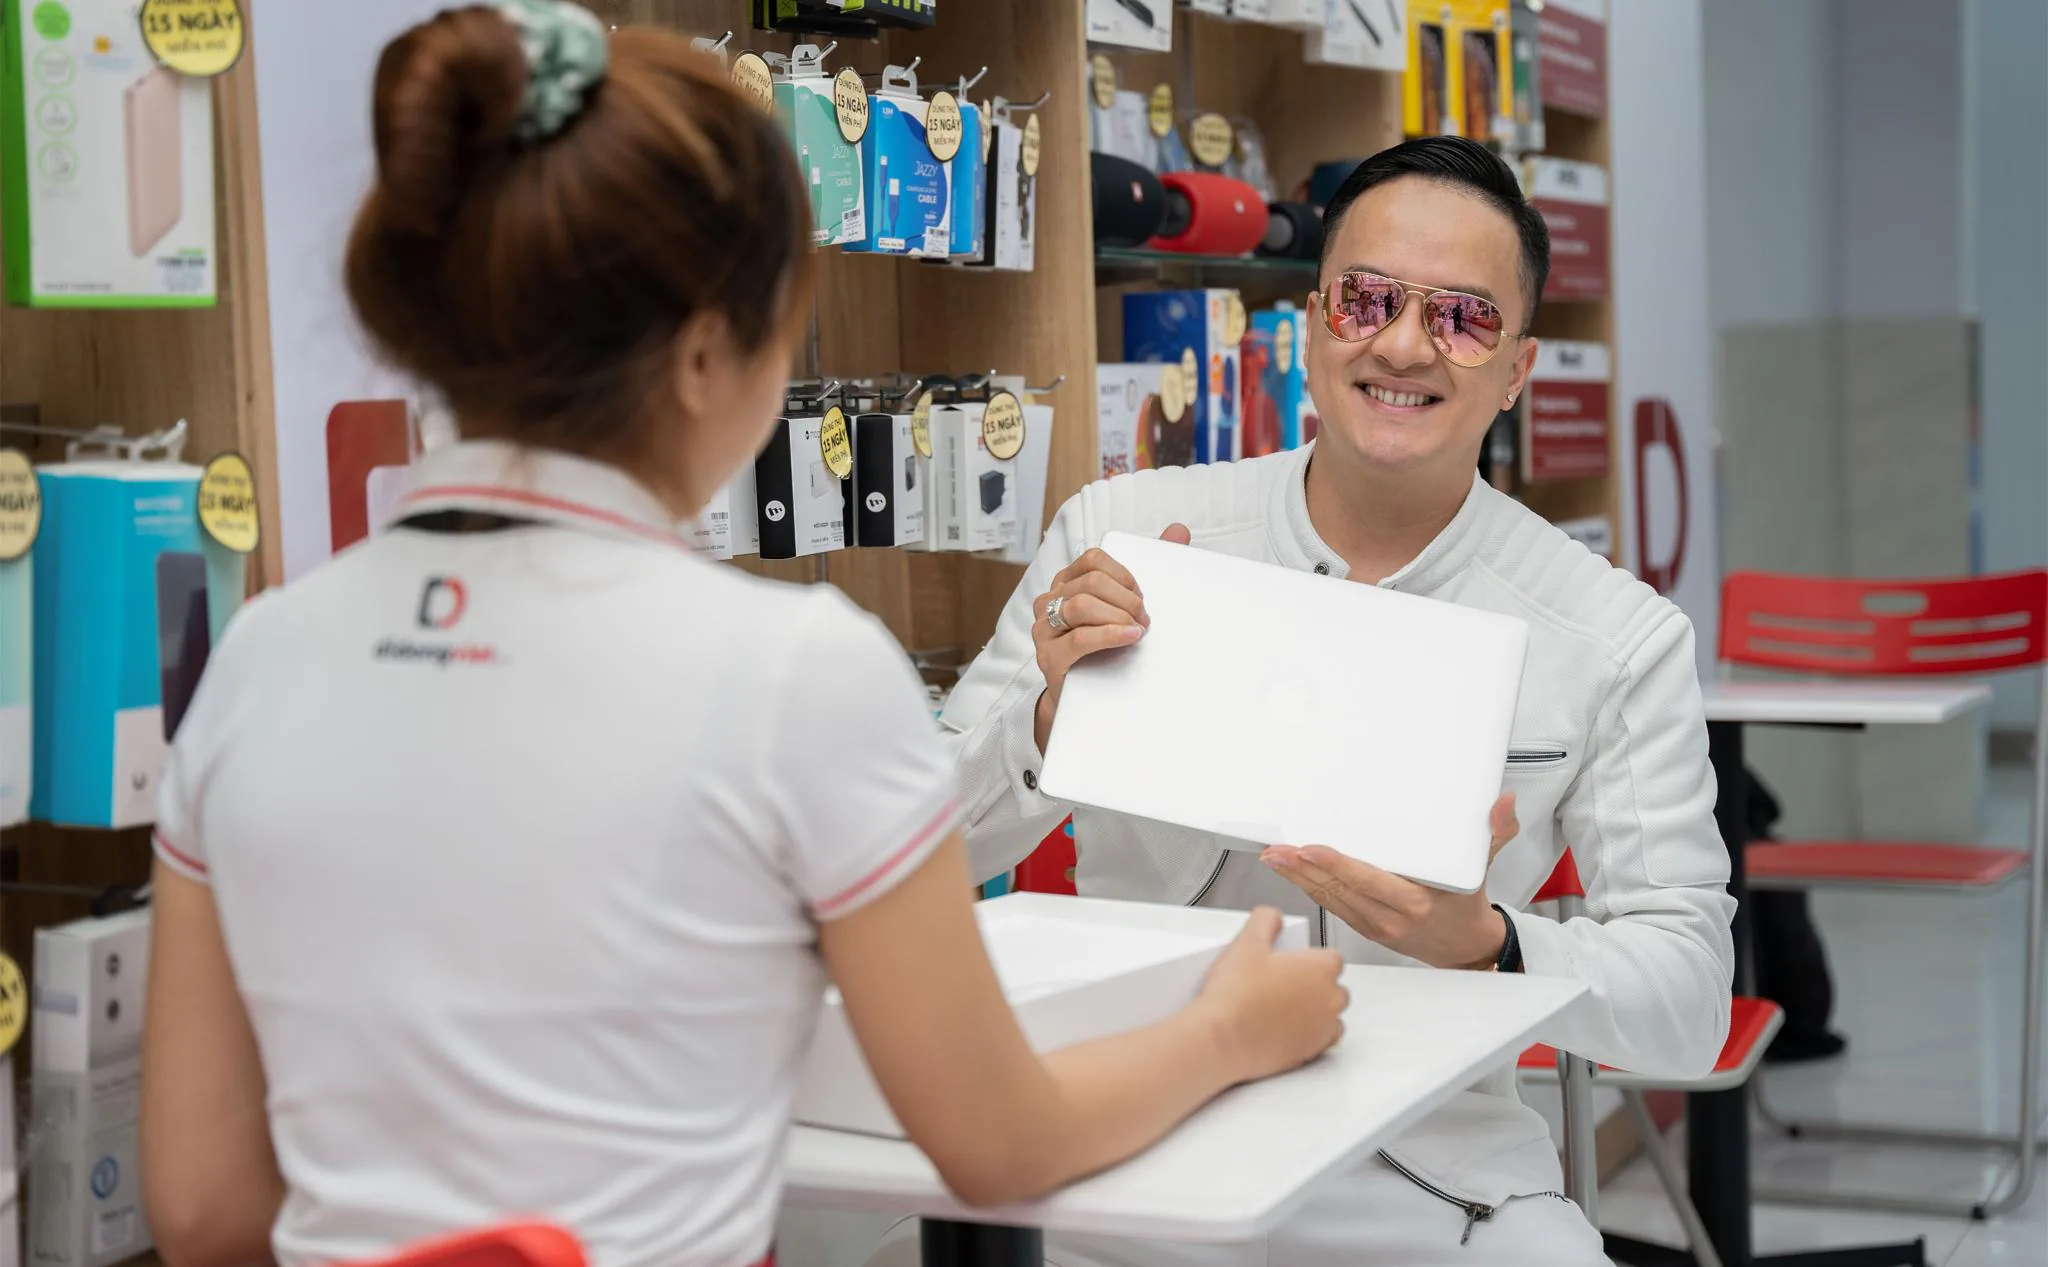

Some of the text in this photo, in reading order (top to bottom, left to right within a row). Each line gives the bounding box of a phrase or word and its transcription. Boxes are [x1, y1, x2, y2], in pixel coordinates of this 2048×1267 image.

[148, 6, 239, 33] 15 NGÀY
[837, 93, 867, 116] 15 NGÀY
[928, 114, 961, 132] 15 NGÀY
[914, 160, 939, 177] JAZZY
[918, 193, 938, 205] CABLE
[986, 413, 1021, 435] 15 NGÀY
[823, 427, 847, 454] 15 NGÀY
